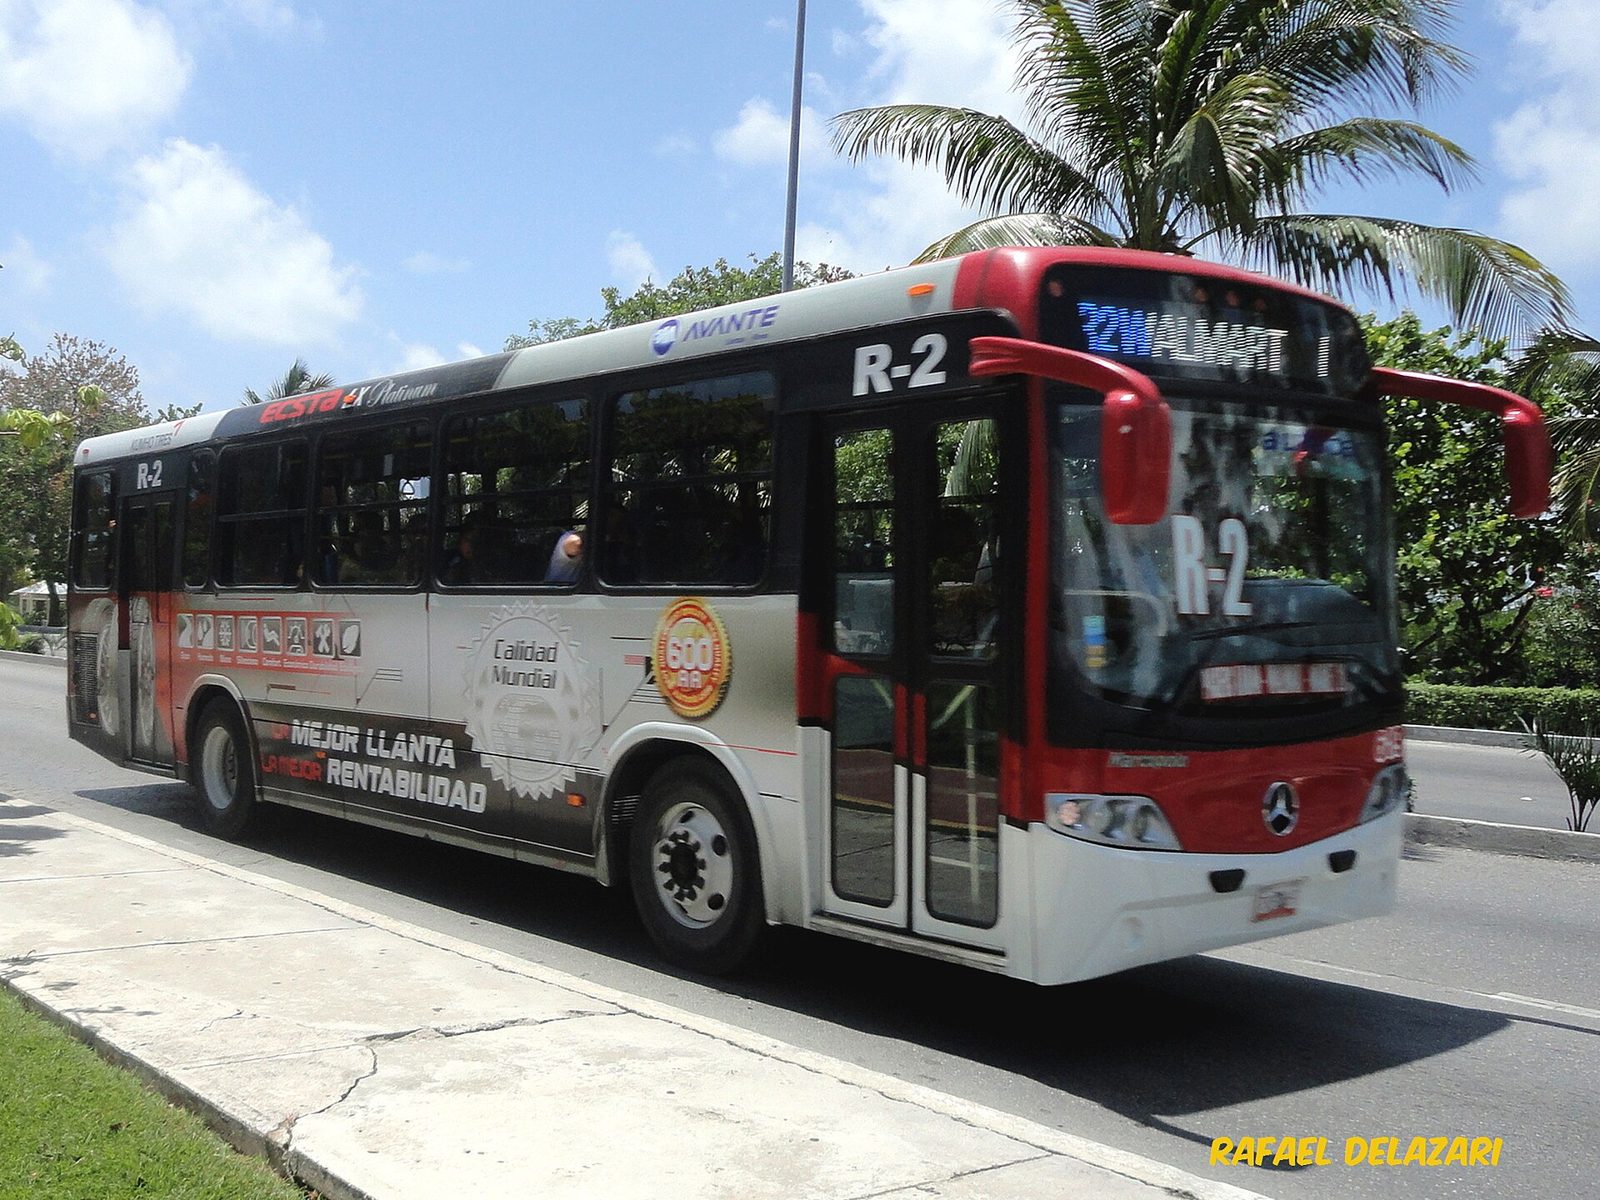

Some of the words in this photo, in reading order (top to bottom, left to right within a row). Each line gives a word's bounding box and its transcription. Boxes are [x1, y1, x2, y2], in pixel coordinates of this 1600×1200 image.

[683, 305, 779, 342] AVANTE
[852, 333, 948, 397] R-2
[367, 378, 439, 408] Platinum
[137, 459, 163, 490] R-2
[1172, 514, 1252, 616] R-2
[494, 638, 560, 663] Calidad
[666, 636, 714, 671] 600
[491, 664, 558, 689] Mundial
[291, 718, 359, 753] MEJOR
[365, 727, 456, 769] LLANTA
[326, 757, 488, 814] RENTABILIDAD
